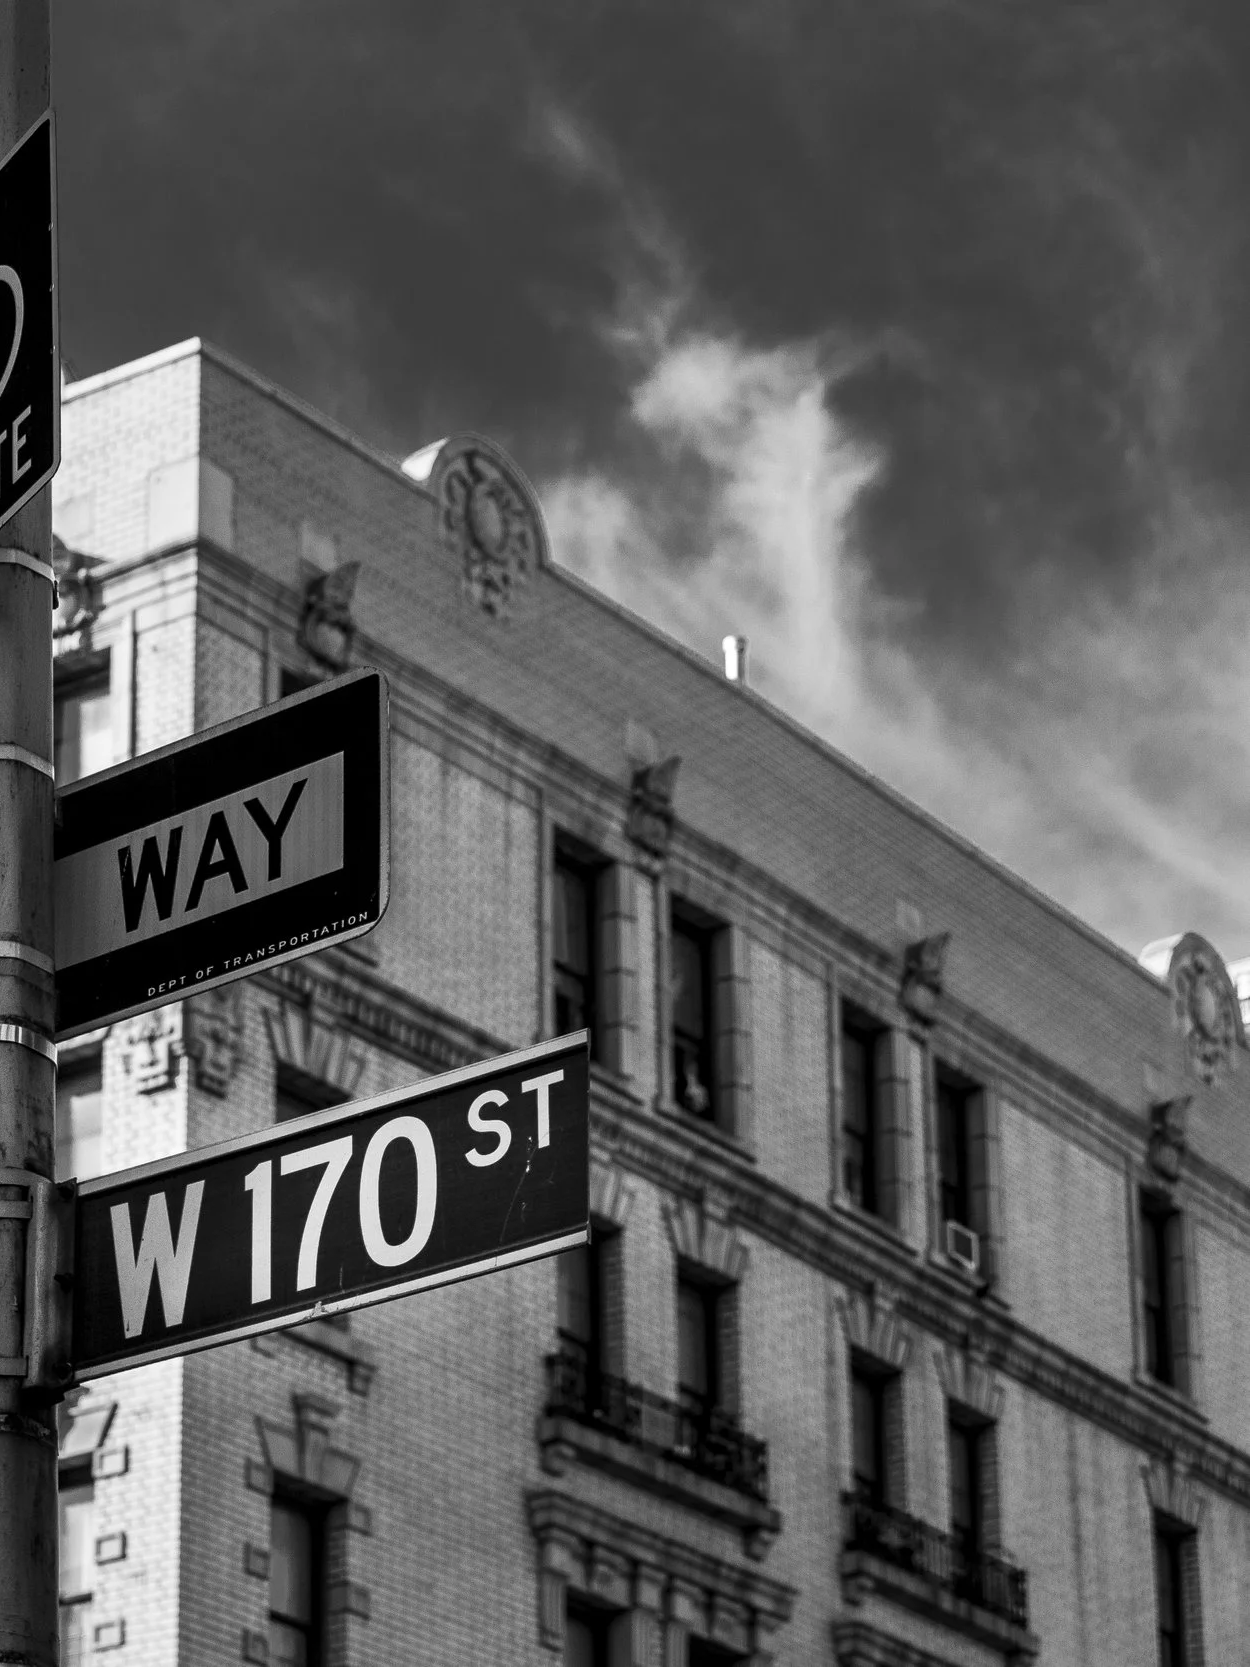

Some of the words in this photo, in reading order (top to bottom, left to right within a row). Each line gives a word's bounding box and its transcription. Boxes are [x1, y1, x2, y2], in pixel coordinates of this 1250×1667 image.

[117, 777, 309, 934] WAY
[147, 975, 187, 997] DEPT
[195, 965, 214, 980] OF
[223, 911, 368, 969] TRANSPORTATION
[110, 1179, 206, 1339] W
[244, 1115, 438, 1305] 170
[464, 1068, 565, 1168] ST
